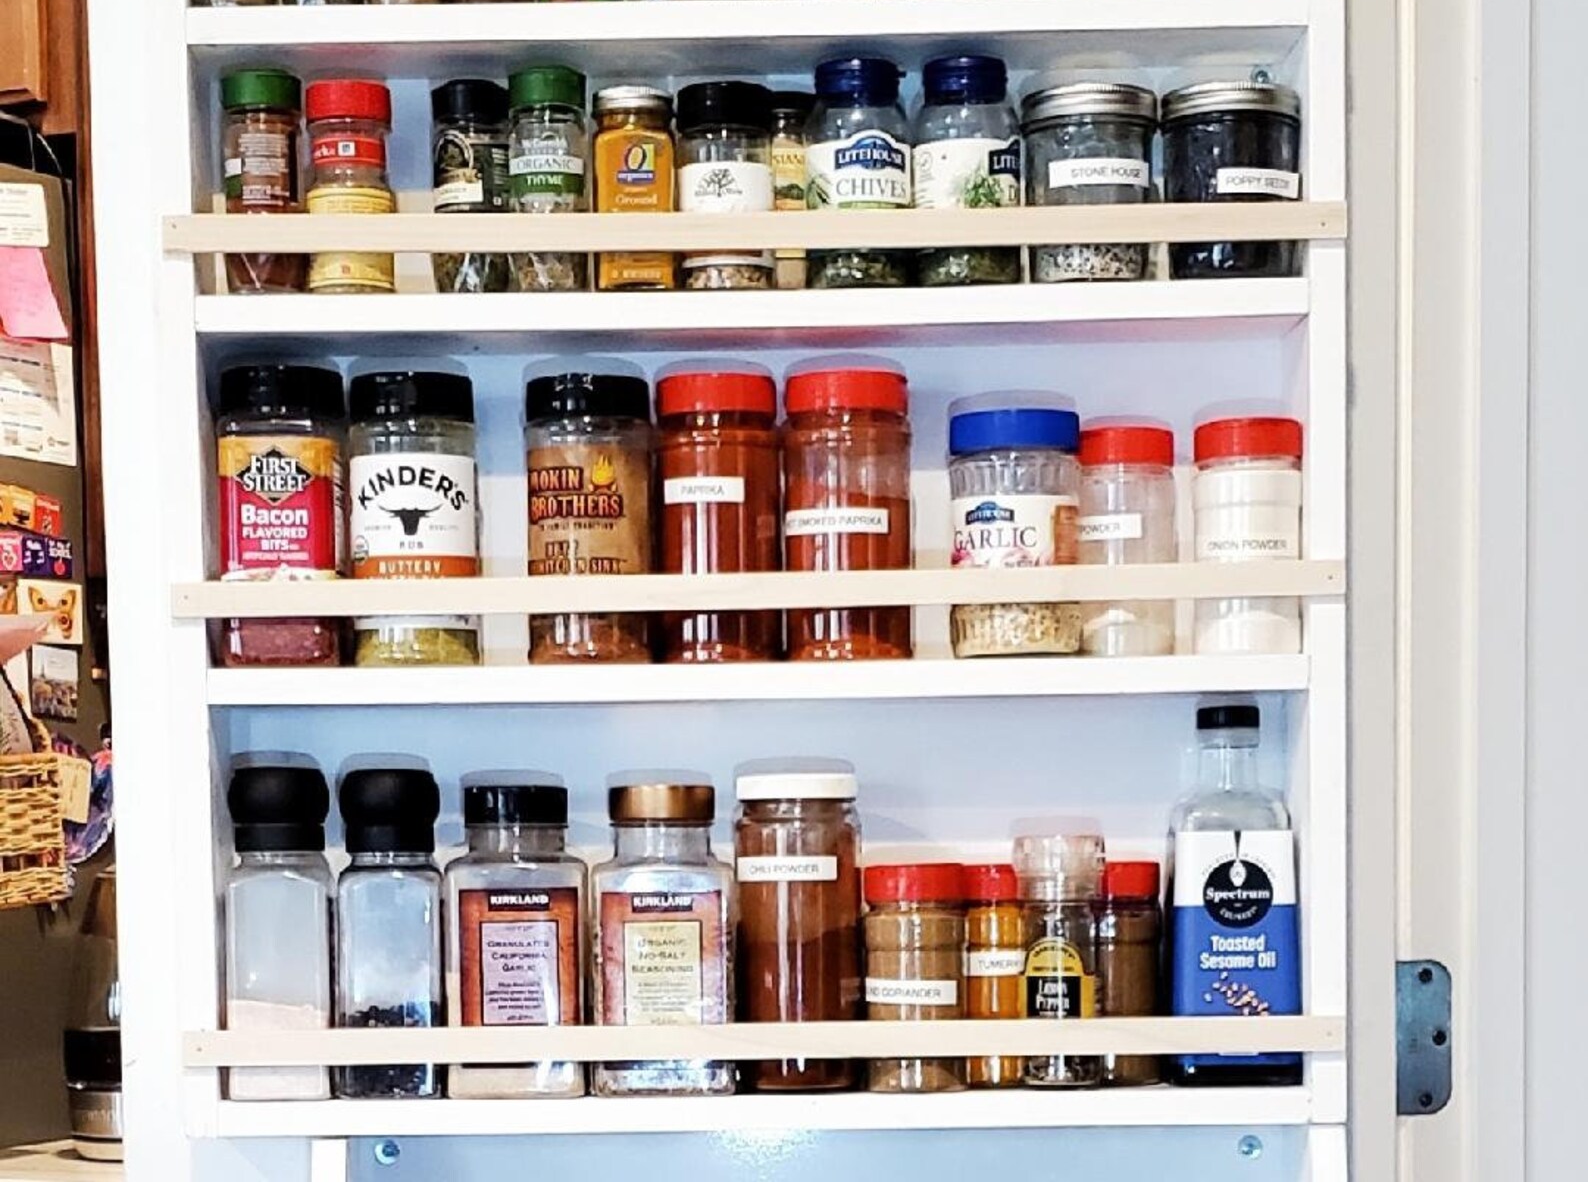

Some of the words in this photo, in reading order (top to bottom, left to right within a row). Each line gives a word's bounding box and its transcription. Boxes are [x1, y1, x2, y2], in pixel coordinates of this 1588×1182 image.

[516, 158, 572, 172] ORGANIC
[837, 148, 905, 165] LITEHOUSE
[526, 174, 563, 186] THYME
[836, 177, 908, 198] CHIVES
[615, 194, 658, 205] Ground
[251, 455, 301, 475] FIRST
[243, 473, 308, 493] STREET
[358, 465, 468, 511] KINDER'S
[530, 469, 581, 492] MOKIN
[681, 485, 725, 495] PAPRIKA
[240, 504, 309, 526] Bacon
[531, 495, 622, 518] BROTHERS
[242, 526, 308, 539] FLAVORED
[954, 526, 1038, 552] GARLIC
[260, 539, 290, 552] BITS
[1242, 539, 1288, 551] POWDER
[378, 560, 442, 574] BUTTERY
[490, 894, 550, 906] KIRKLAND
[632, 895, 692, 908] KIRKLAND
[1205, 886, 1271, 903] Spectrum
[1210, 934, 1266, 952] Toasted
[1200, 951, 1254, 969] Sesame
[1257, 950, 1277, 969] Oil
